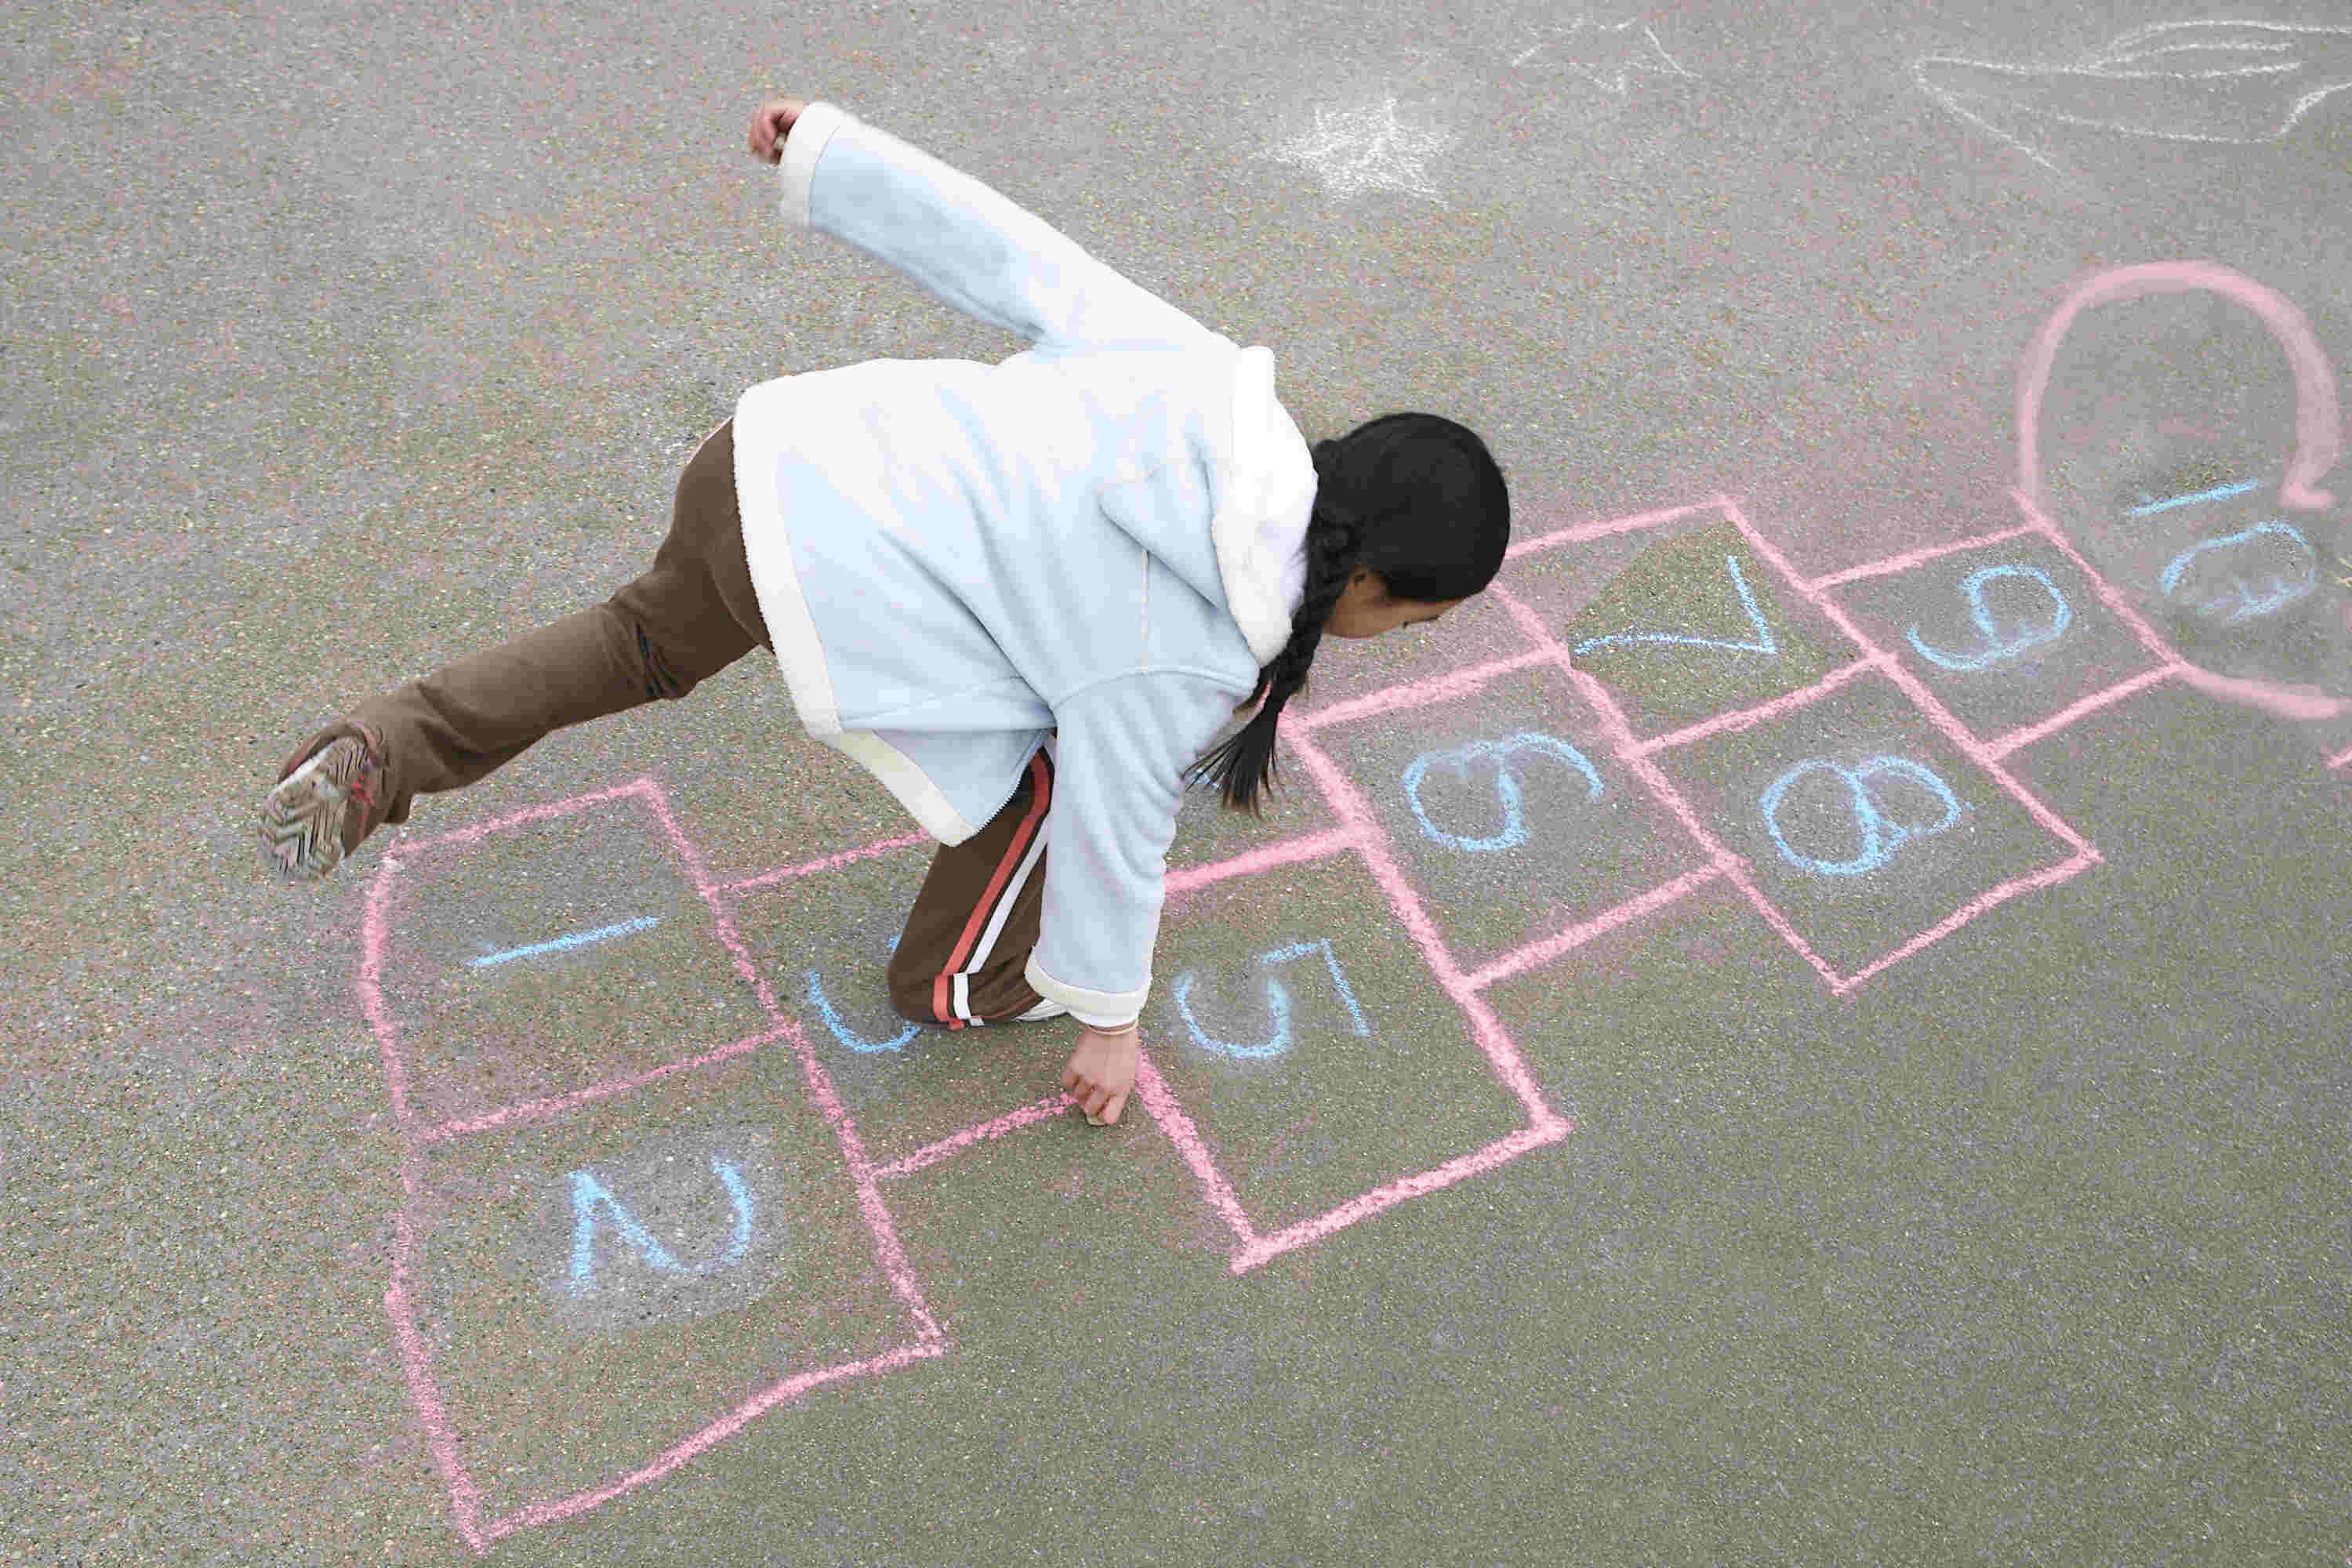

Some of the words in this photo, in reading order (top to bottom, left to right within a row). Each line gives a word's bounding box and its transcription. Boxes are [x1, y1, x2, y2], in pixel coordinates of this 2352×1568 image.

[1573, 554, 1777, 655] 7
[1906, 563, 2071, 671] 9
[1405, 731, 1604, 853] 6
[1759, 755, 1962, 876] 8
[466, 915, 659, 968] 1
[1174, 938, 1370, 1058] 5
[565, 1150, 758, 1299] 2
